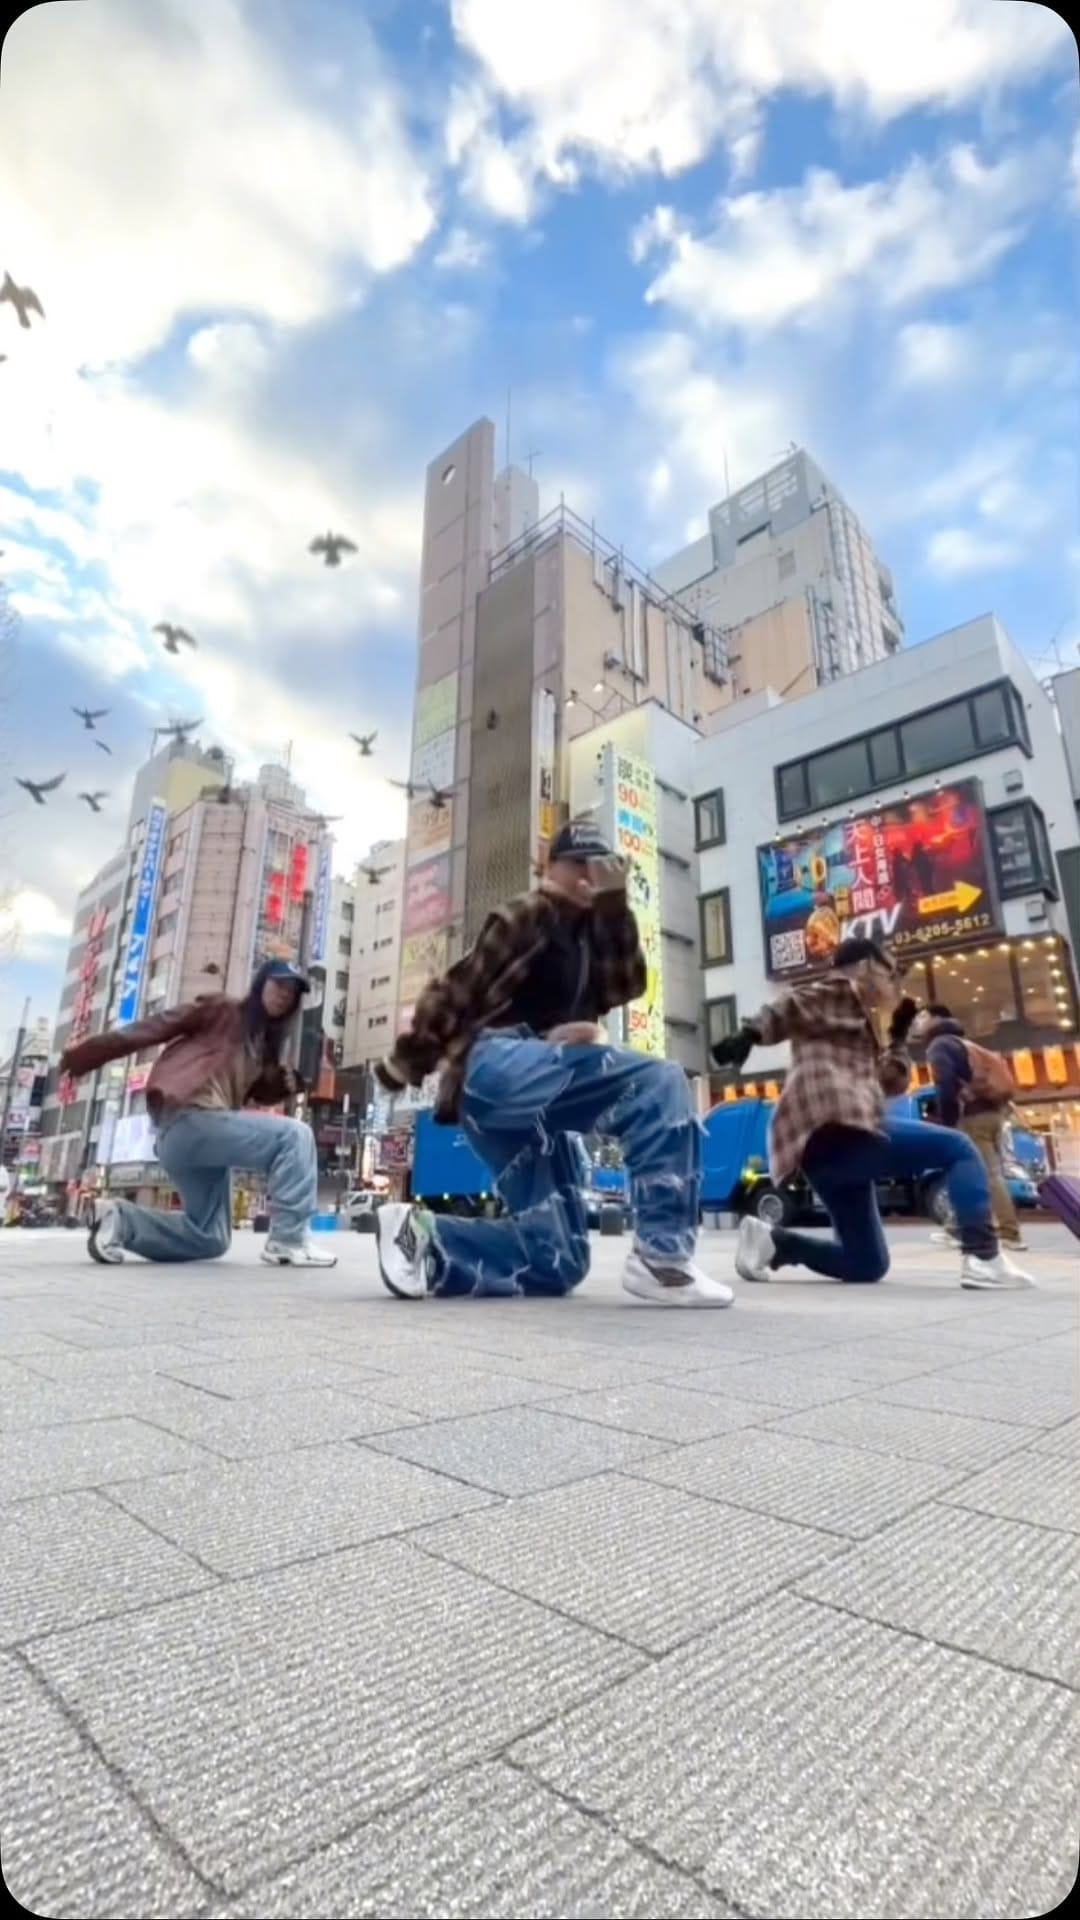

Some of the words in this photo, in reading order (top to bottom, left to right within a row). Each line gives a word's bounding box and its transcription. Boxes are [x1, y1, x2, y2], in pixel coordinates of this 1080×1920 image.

[843, 818, 876, 914] 天上人間
[839, 902, 902, 943] KTV
